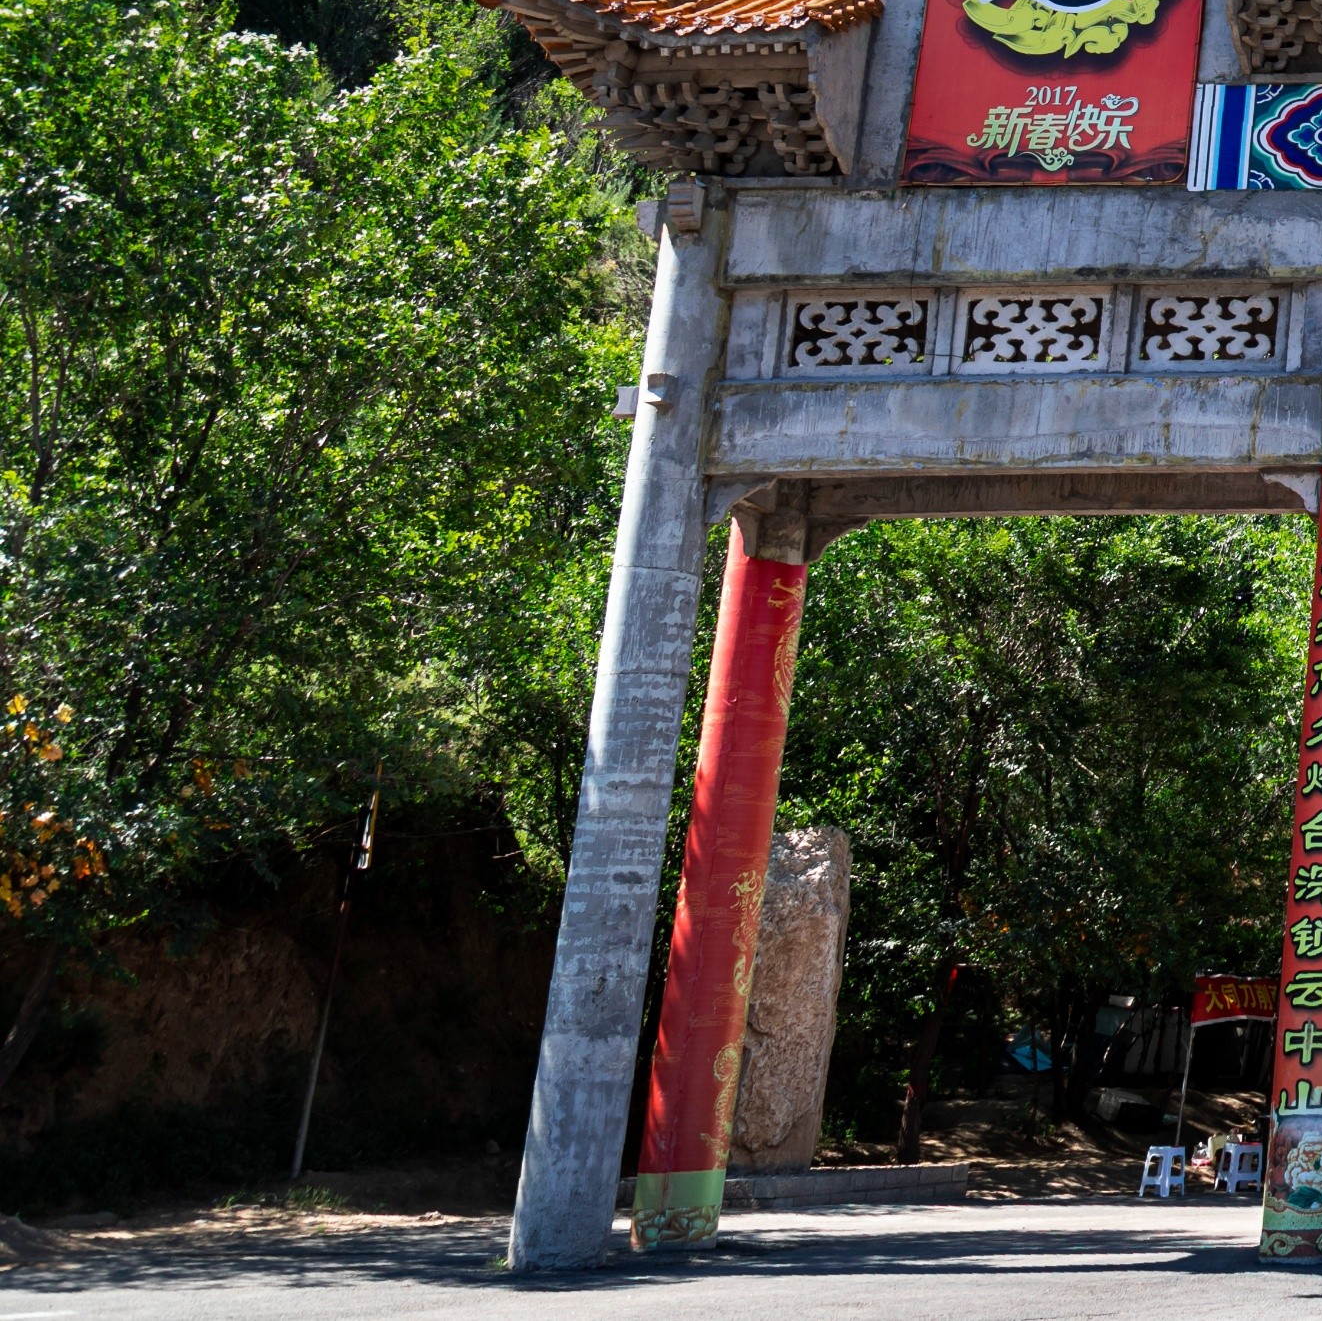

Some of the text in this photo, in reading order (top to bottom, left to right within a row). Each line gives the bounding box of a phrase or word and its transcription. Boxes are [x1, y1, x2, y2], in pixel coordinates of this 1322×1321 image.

[1024, 86, 1078, 108] 2017
[966, 95, 1140, 158] 新春快乐
